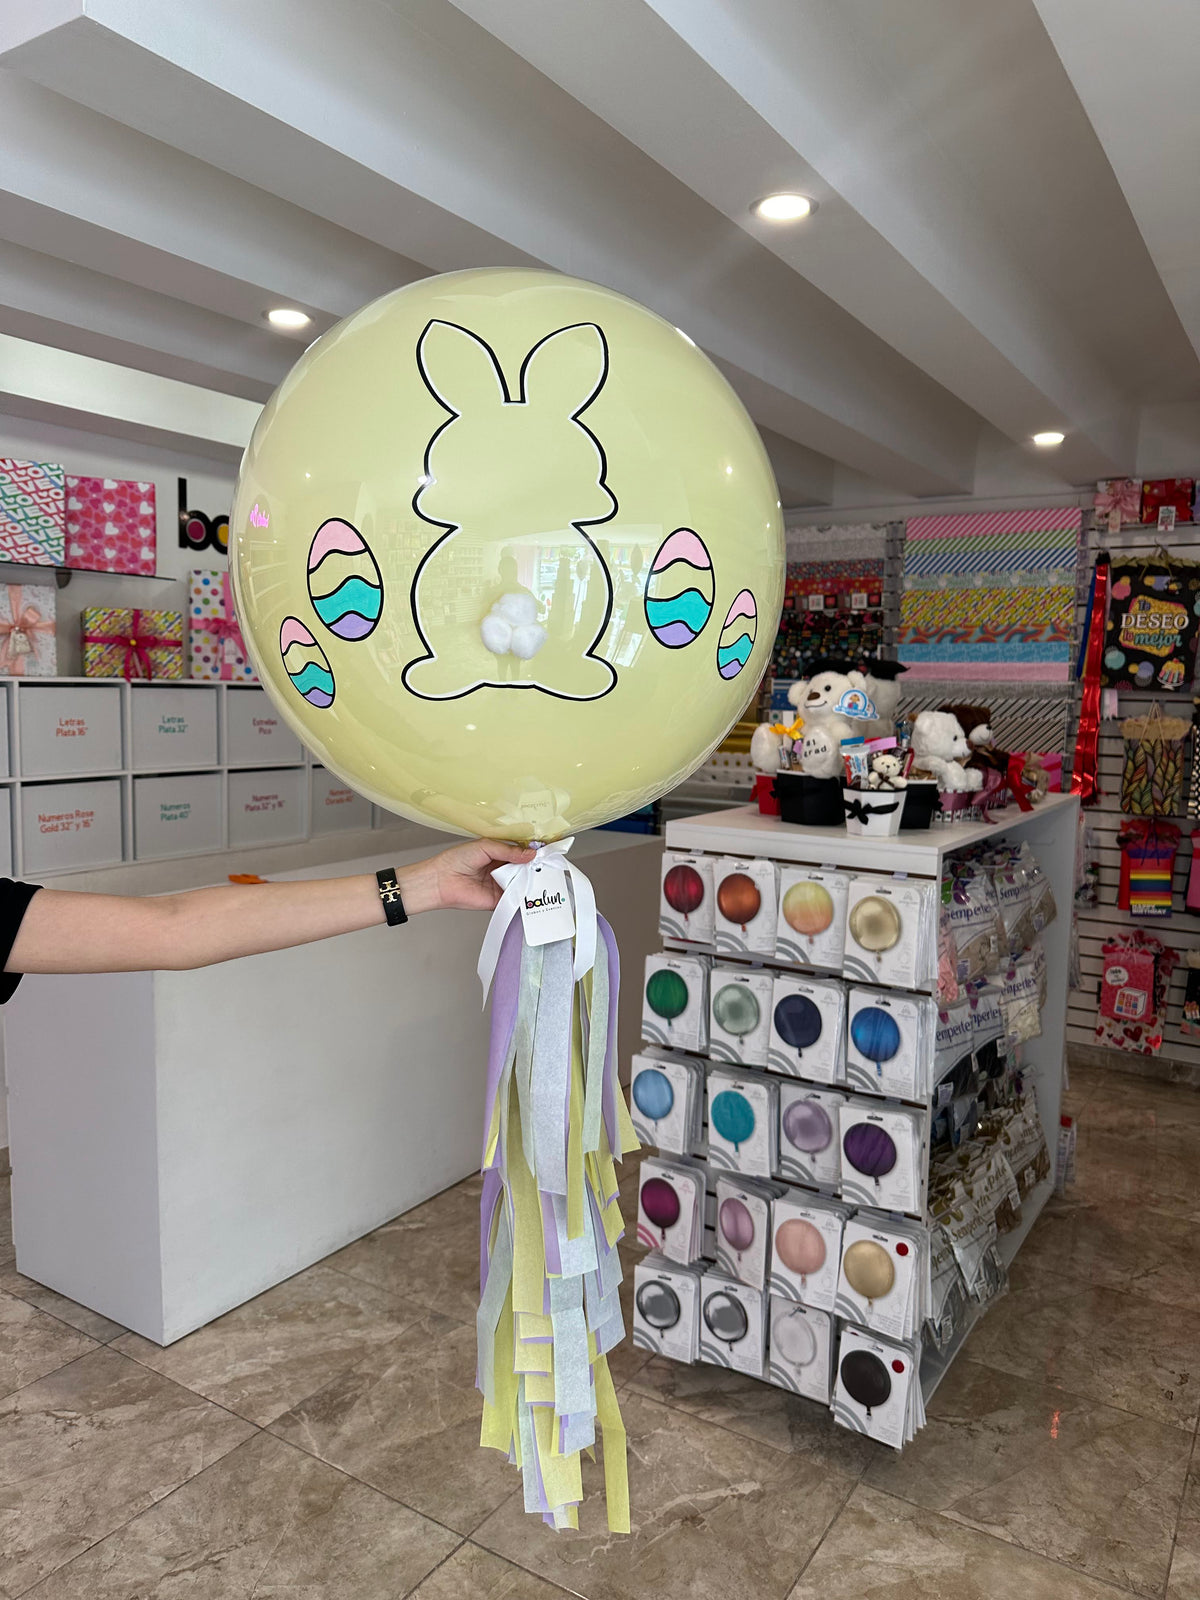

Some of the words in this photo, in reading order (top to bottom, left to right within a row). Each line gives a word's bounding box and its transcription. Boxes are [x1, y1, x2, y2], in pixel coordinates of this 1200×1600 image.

[1121, 613, 1189, 630] DESEO
[1134, 629, 1183, 649] mejor
[59, 718, 85, 726] Letras
[162, 716, 184, 724] Letras
[56, 728, 76, 737] Plata
[158, 725, 176, 733] Plata
[38, 814, 74, 823] Numeros
[75, 809, 94, 818] Rose
[40, 823, 59, 833] Gold
